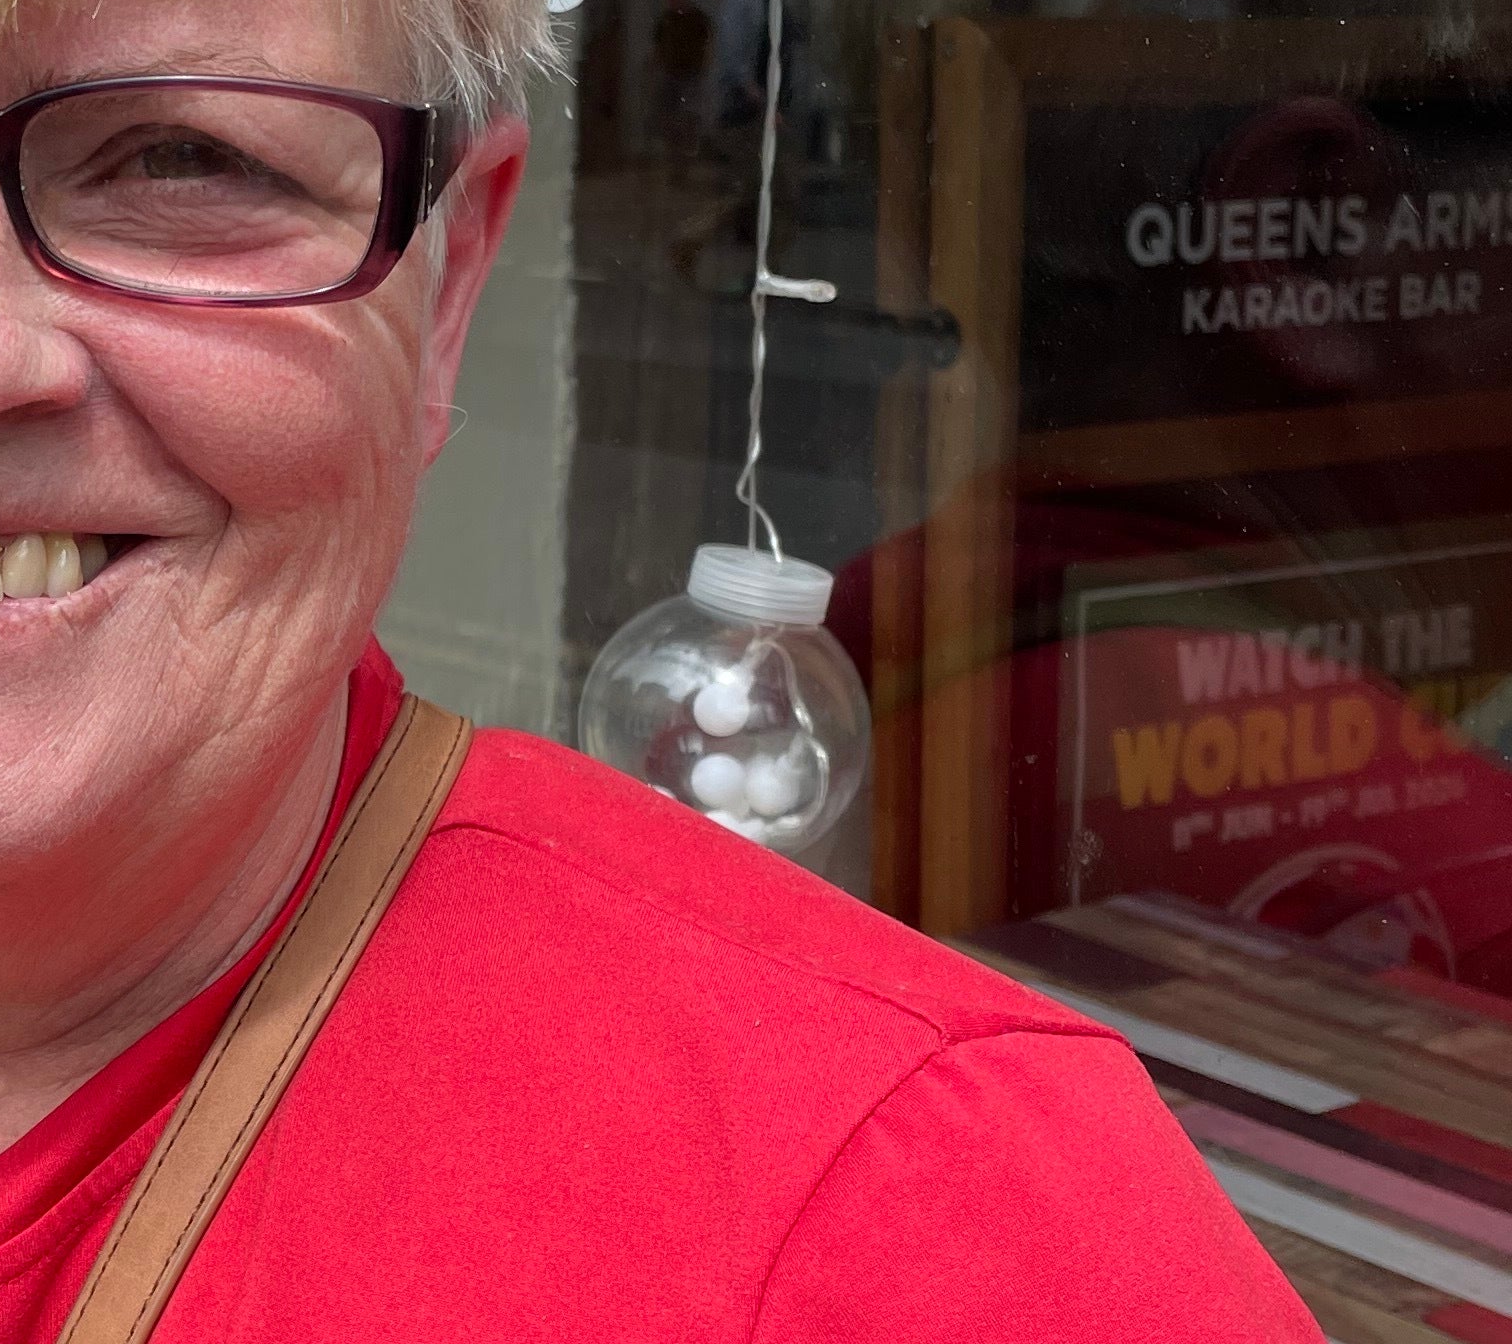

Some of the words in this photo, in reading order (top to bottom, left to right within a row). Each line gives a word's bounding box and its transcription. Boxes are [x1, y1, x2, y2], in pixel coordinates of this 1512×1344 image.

[1125, 194, 1368, 267] QUEENS
[1384, 190, 1512, 254] ARM
[1181, 275, 1389, 336] KARAOKE
[1398, 269, 1483, 321] BAR
[1176, 620, 1365, 705] WATCH
[1381, 604, 1475, 674] THE
[1113, 694, 1377, 811] WORLD
